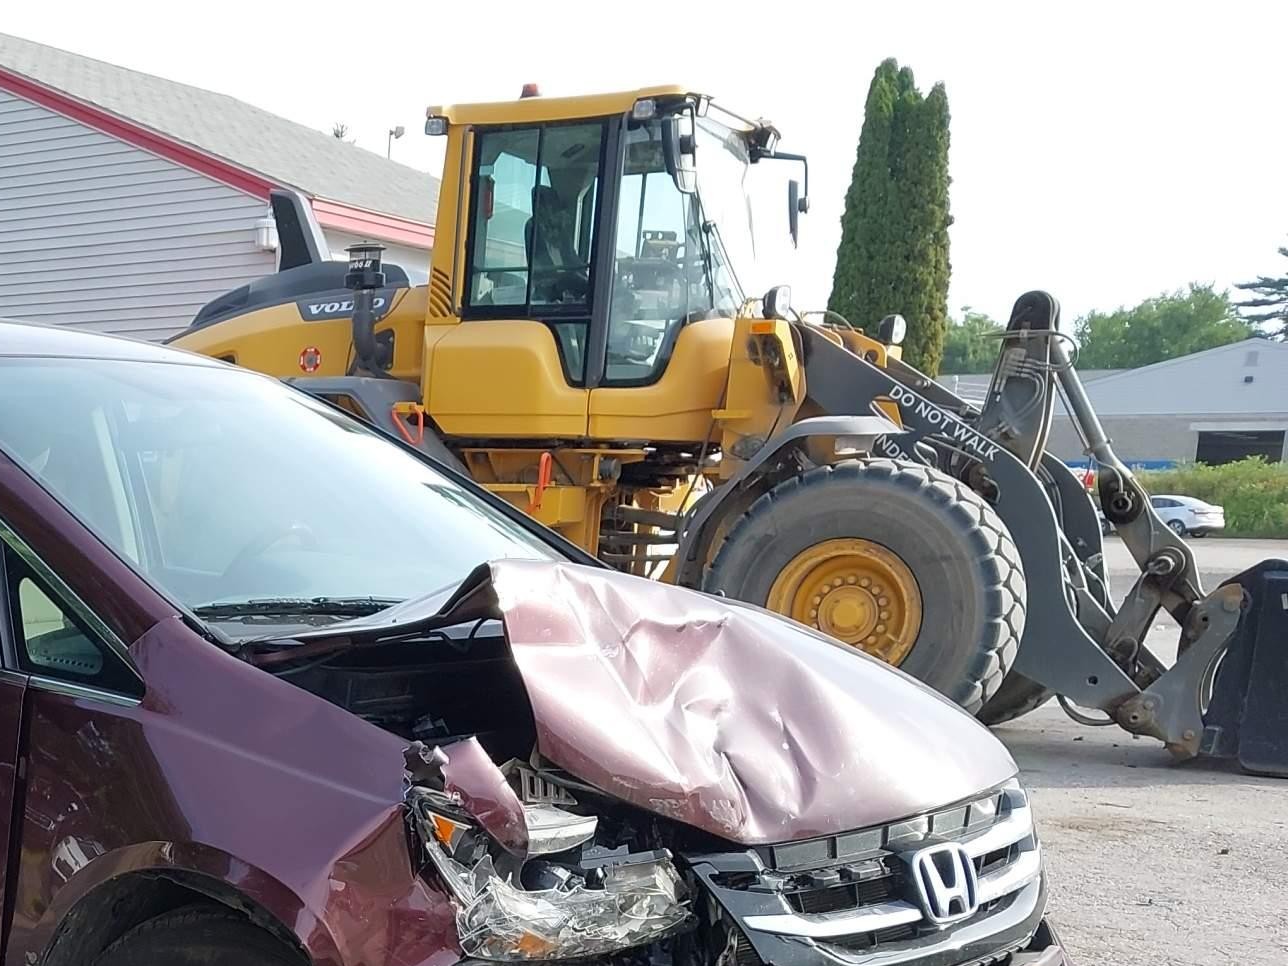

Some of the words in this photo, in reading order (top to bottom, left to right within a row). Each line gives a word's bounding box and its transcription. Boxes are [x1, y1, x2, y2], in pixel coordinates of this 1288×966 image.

[308, 298, 385, 314] VOLO
[889, 385, 915, 406] DO
[915, 402, 953, 429] NOT
[953, 424, 1000, 462] WALK
[874, 433, 914, 462] NDE
